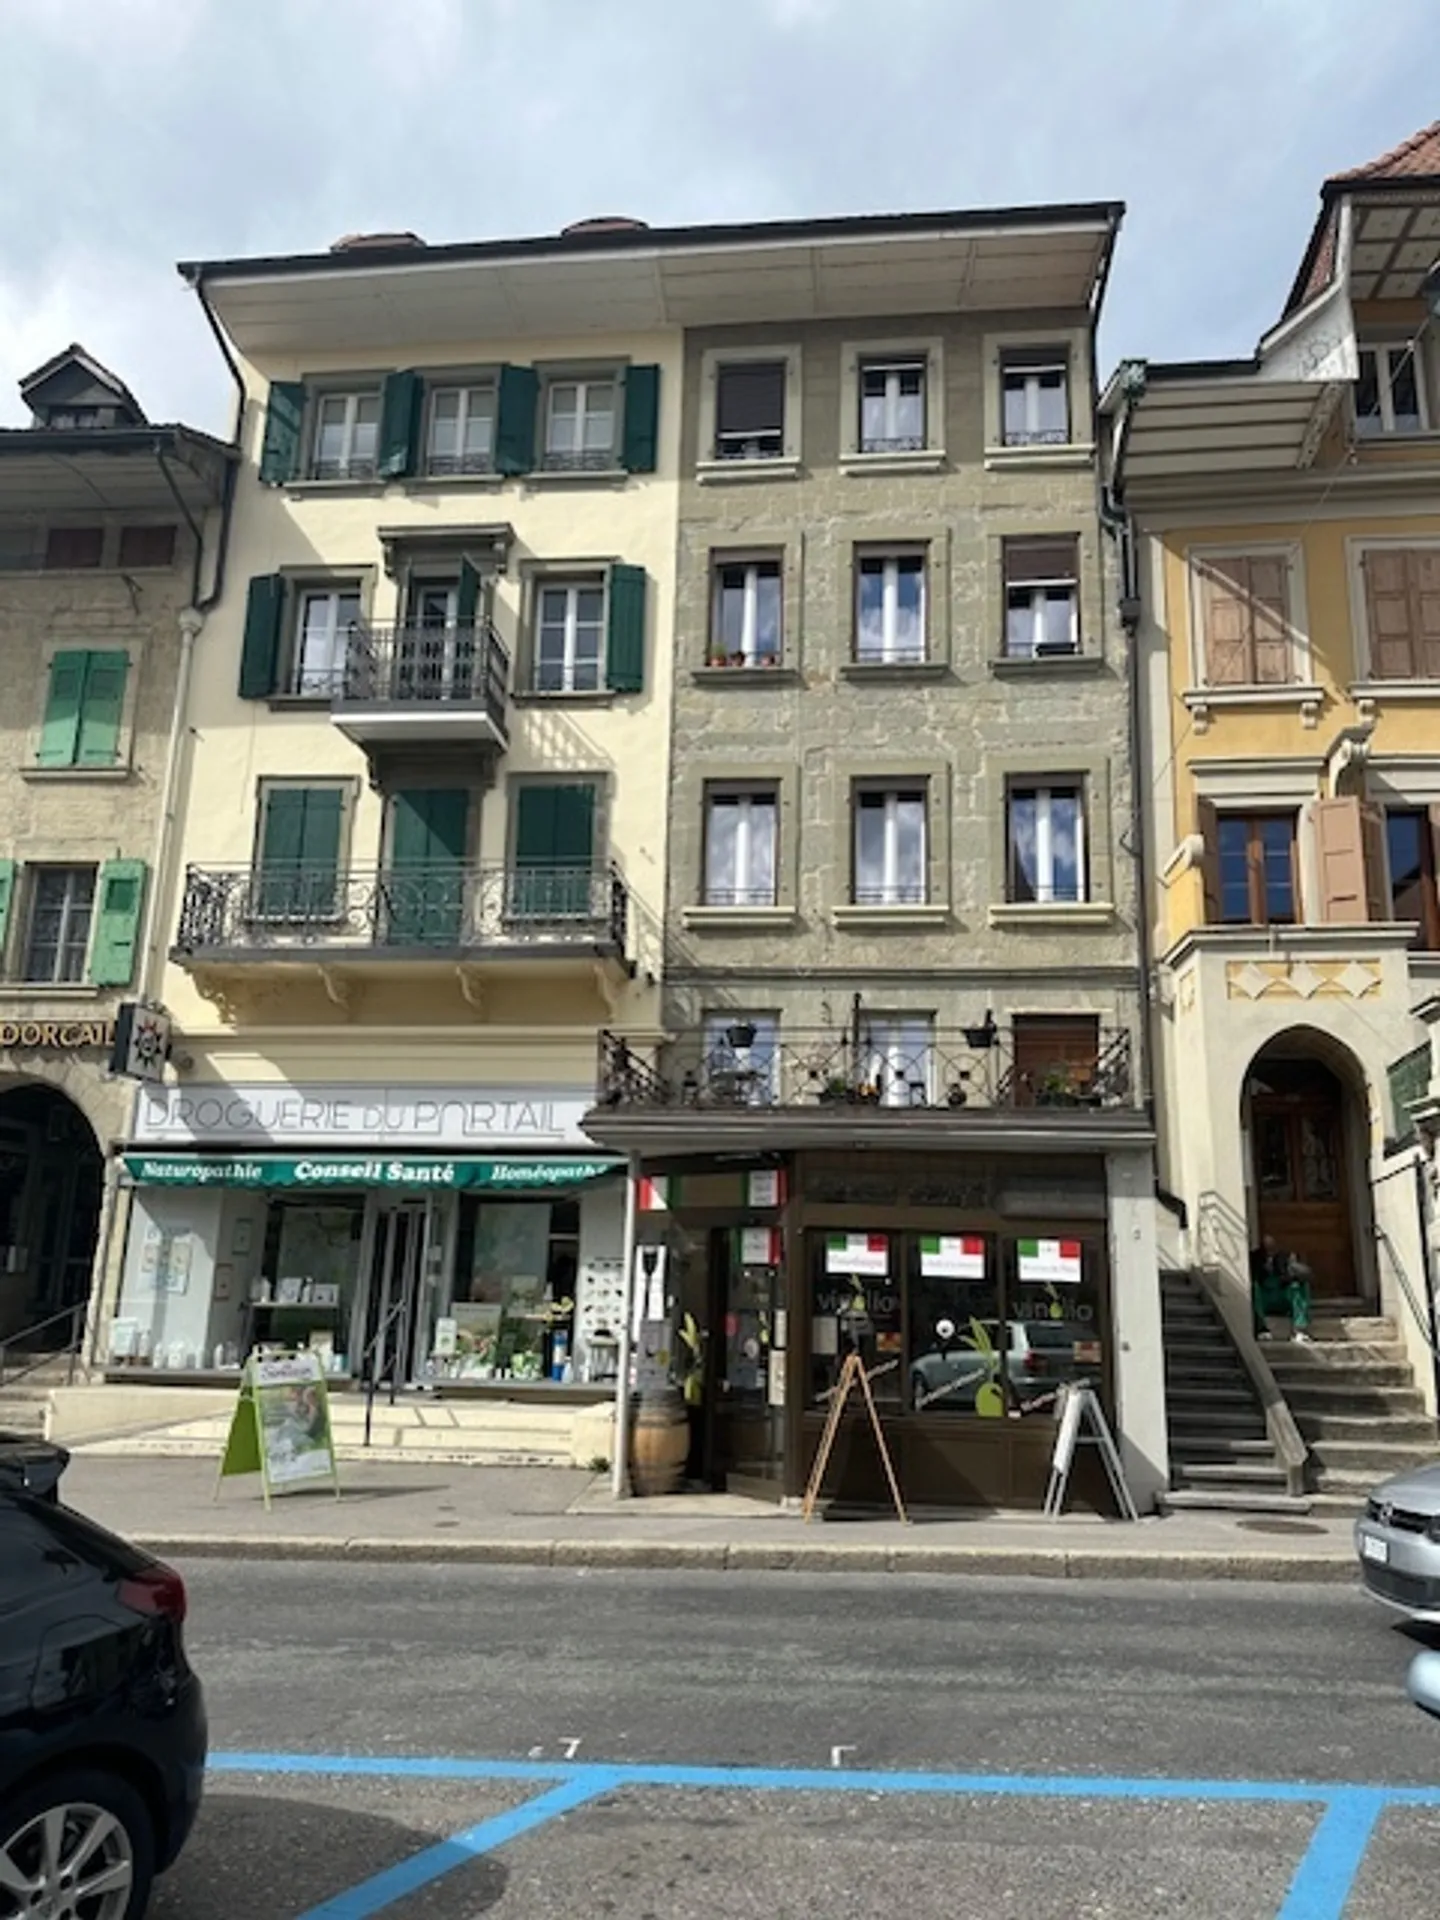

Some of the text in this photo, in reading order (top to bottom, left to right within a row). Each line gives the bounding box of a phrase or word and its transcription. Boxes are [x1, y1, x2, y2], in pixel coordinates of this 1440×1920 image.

[145, 1099, 349, 1131] DROGUERIE
[362, 1104, 405, 1130] DU
[141, 1161, 262, 1182] Naturopathie
[294, 1160, 454, 1183] Conseil Santé
